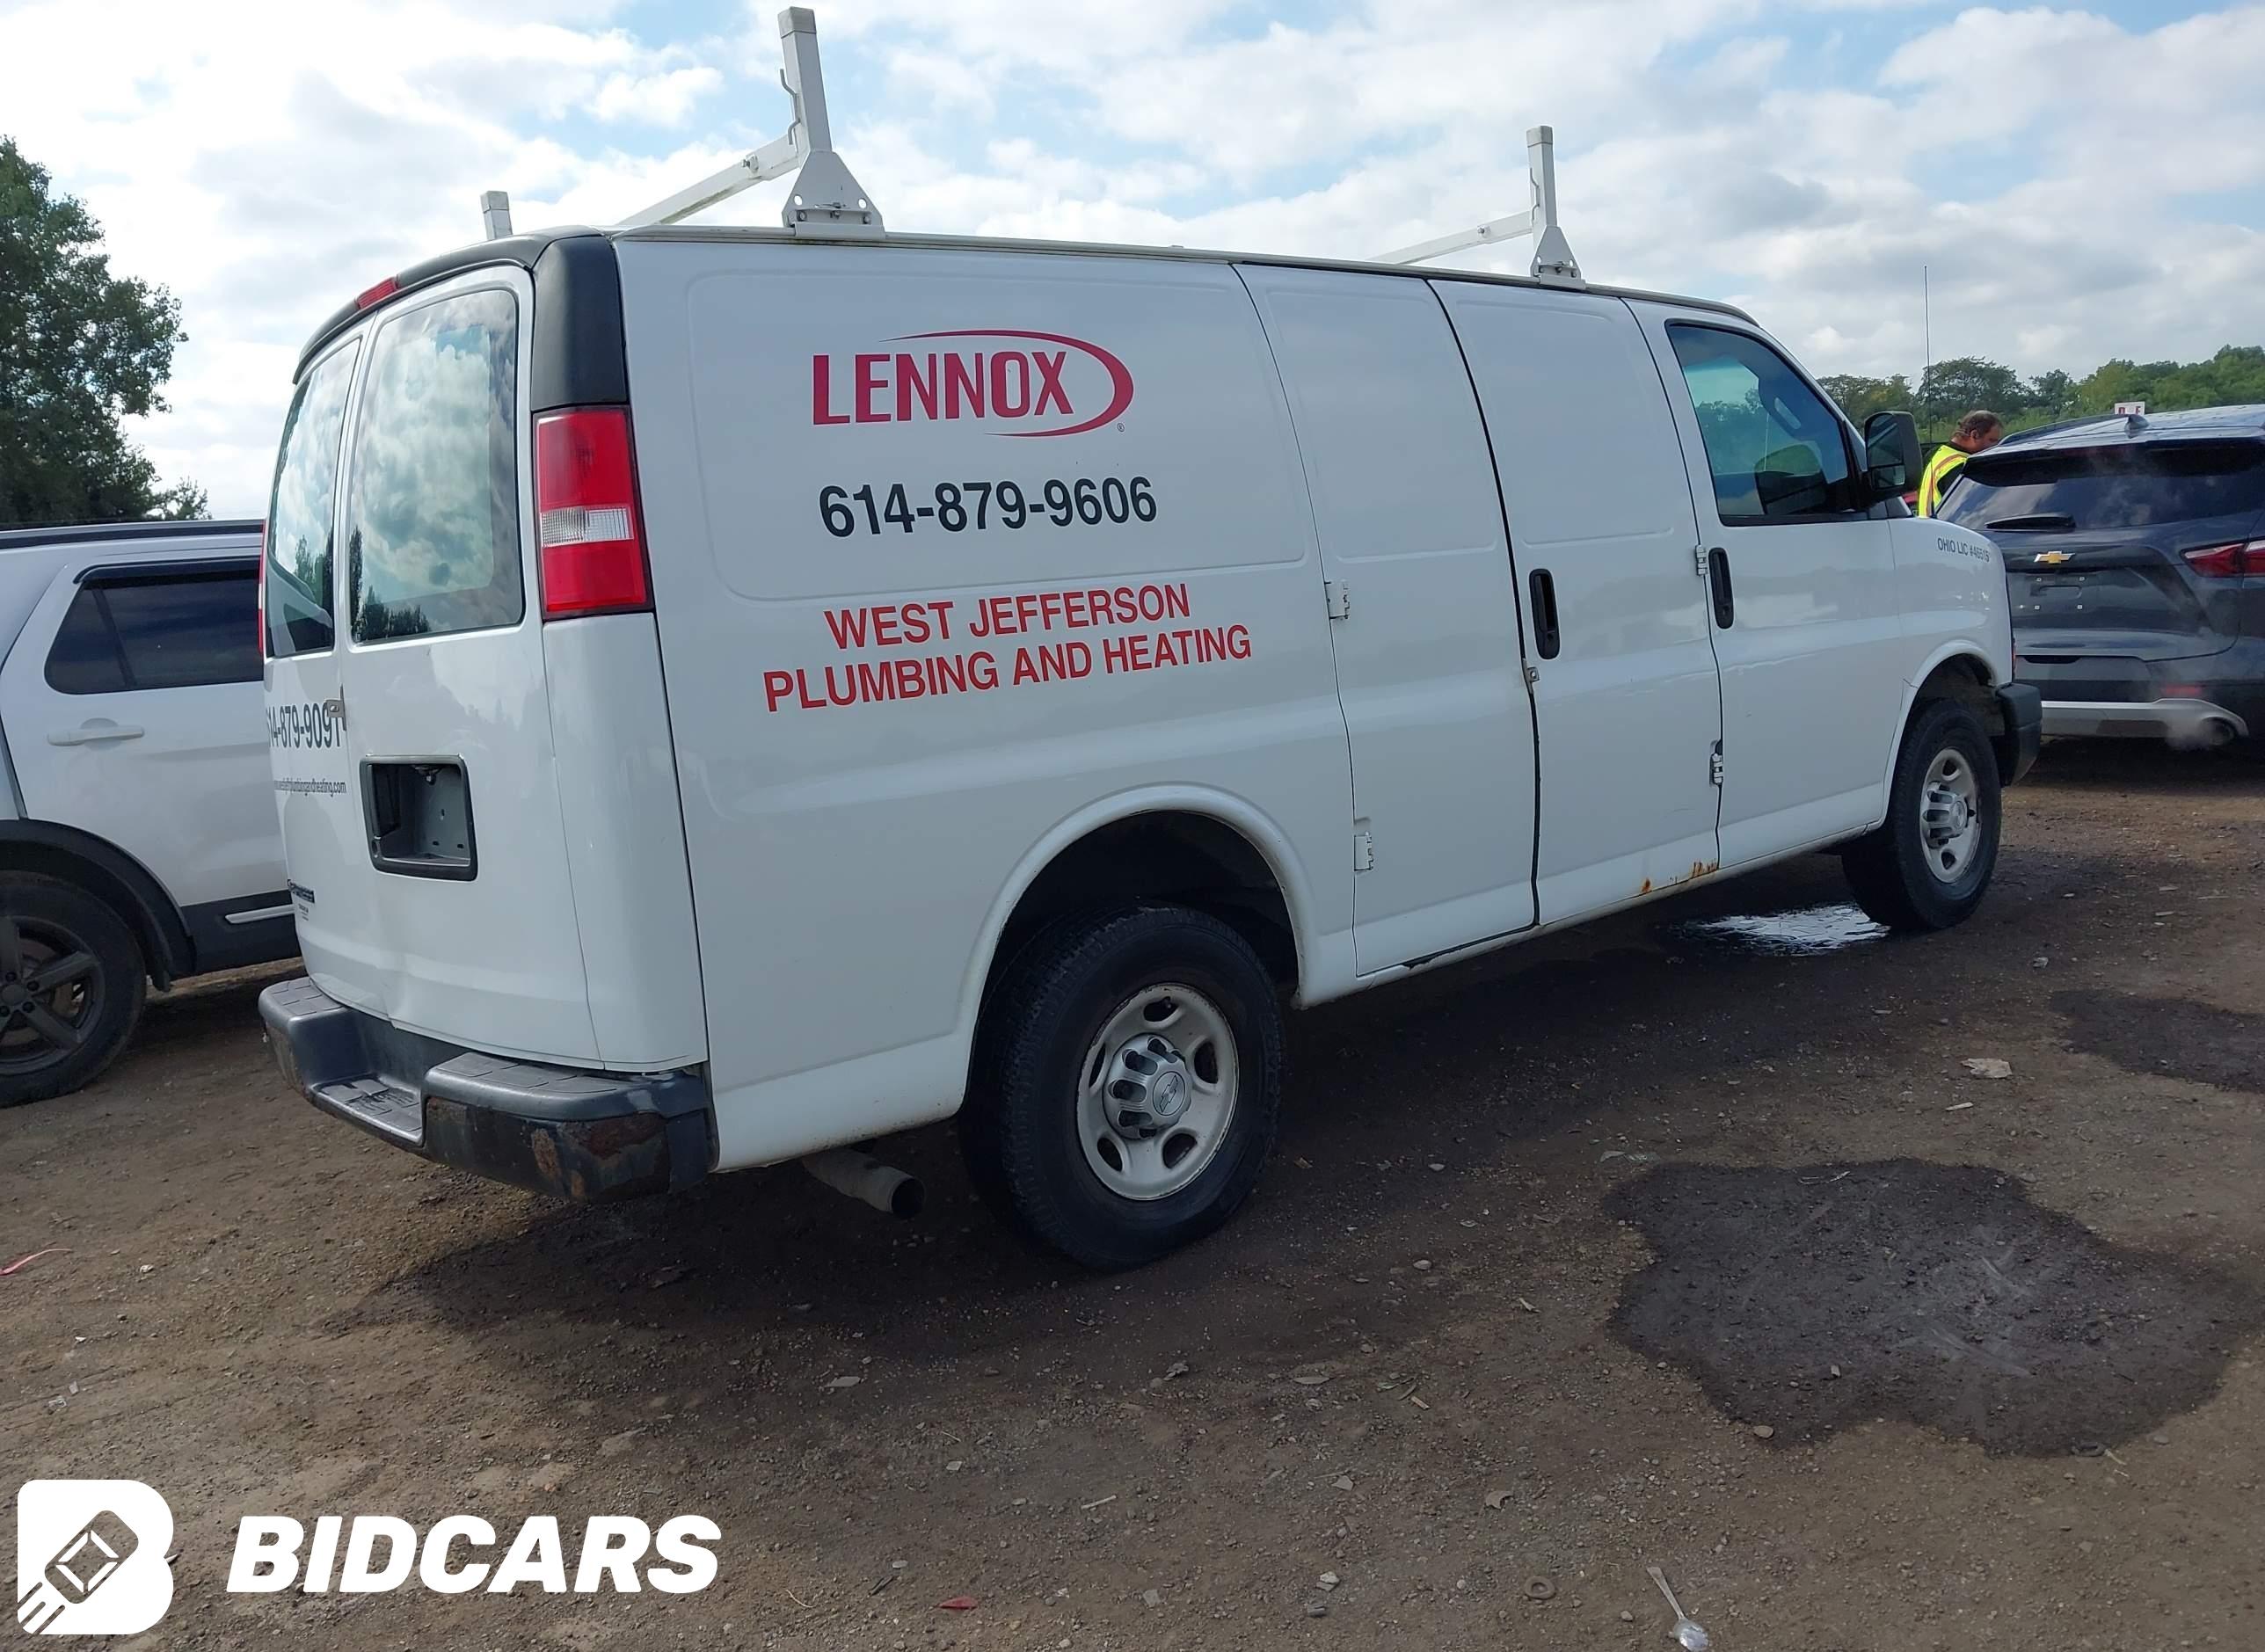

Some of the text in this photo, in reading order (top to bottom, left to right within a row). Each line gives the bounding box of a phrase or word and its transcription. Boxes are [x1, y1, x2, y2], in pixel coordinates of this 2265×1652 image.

[812, 351, 1074, 425] LENNOX
[819, 476, 1158, 538] 614-879-9606
[1937, 537, 1956, 553] OHIO
[1956, 541, 1969, 556] LIC
[824, 583, 1191, 650] WEST JEFFERSON
[763, 623, 1252, 713] PLUMBING AND HEATING
[266, 702, 340, 749] 14-879-9091
